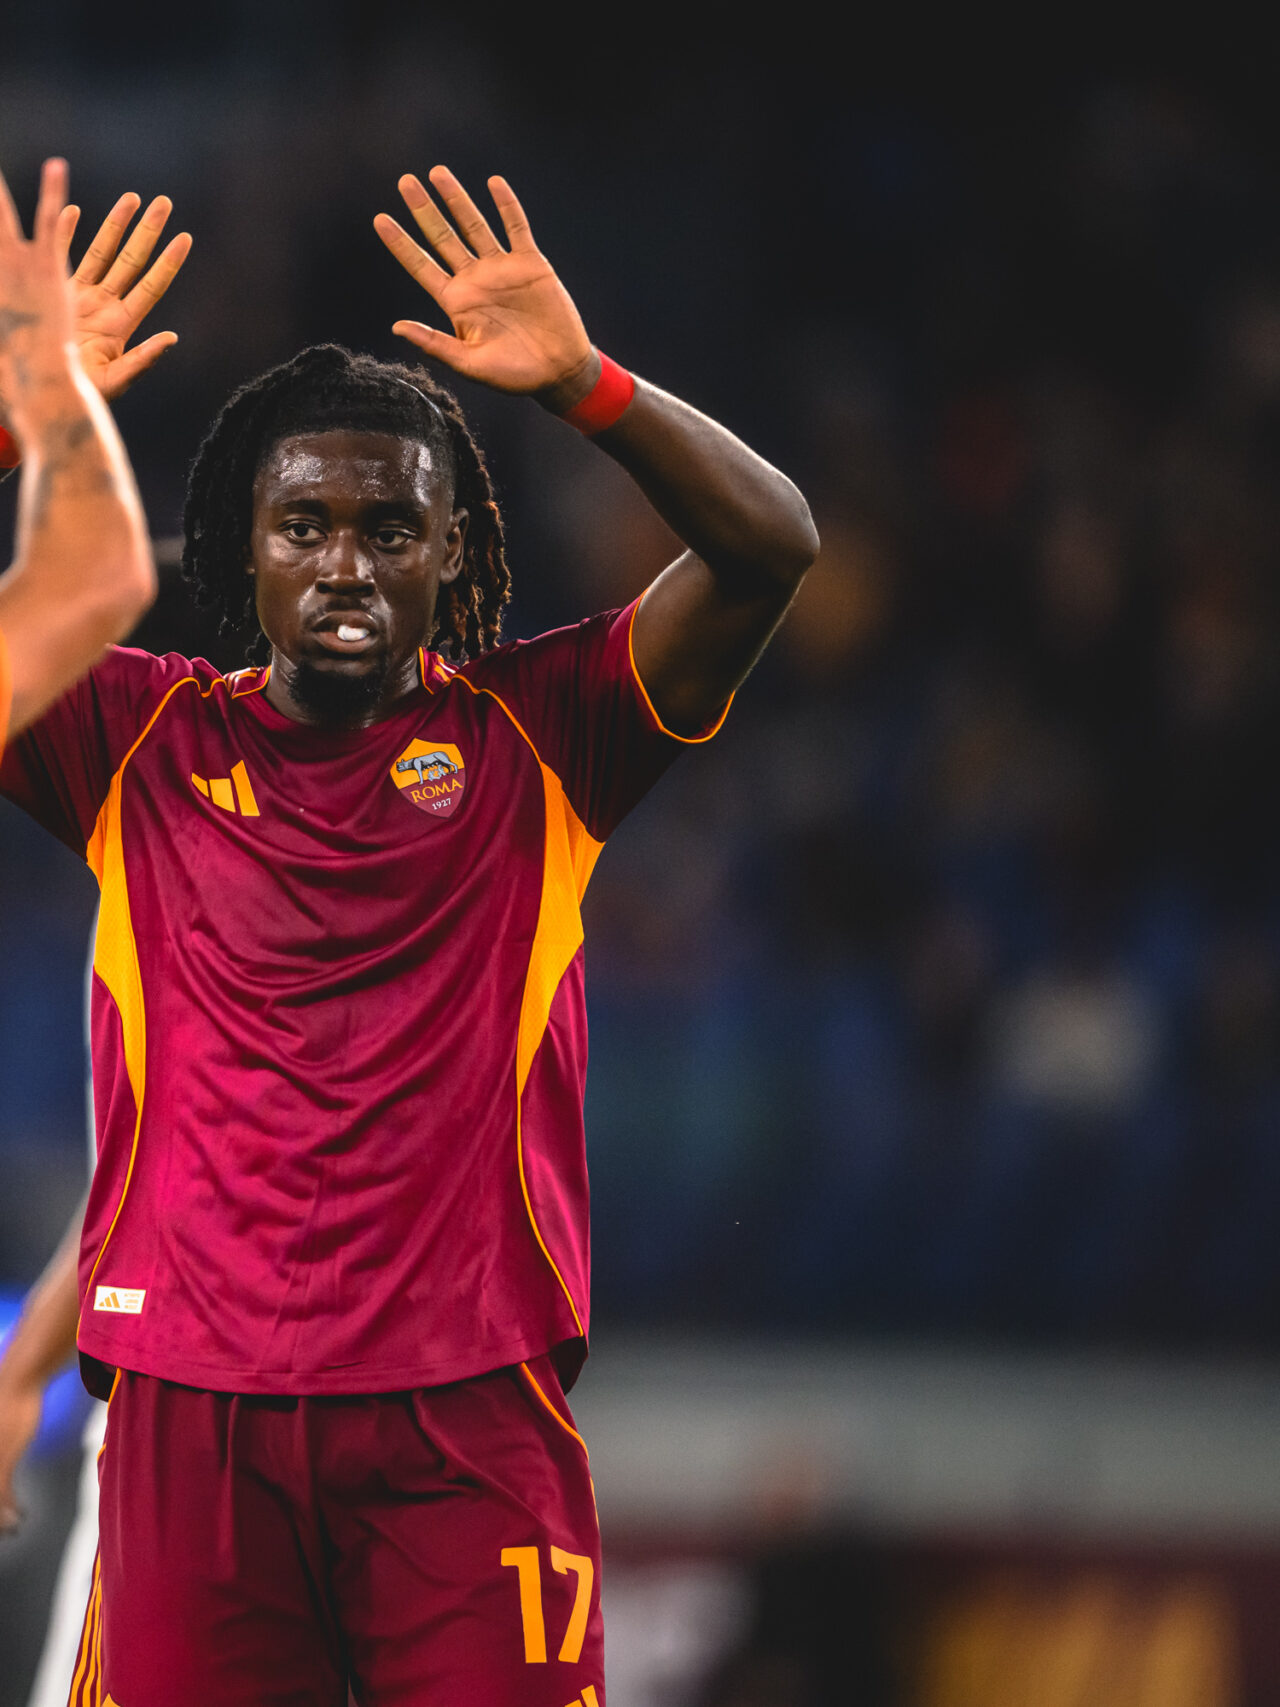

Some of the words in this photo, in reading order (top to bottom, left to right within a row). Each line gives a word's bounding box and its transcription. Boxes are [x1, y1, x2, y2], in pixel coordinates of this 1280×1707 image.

[410, 778, 464, 803] ROMA
[432, 797, 451, 810] 1927
[500, 1544, 594, 1664] 17
